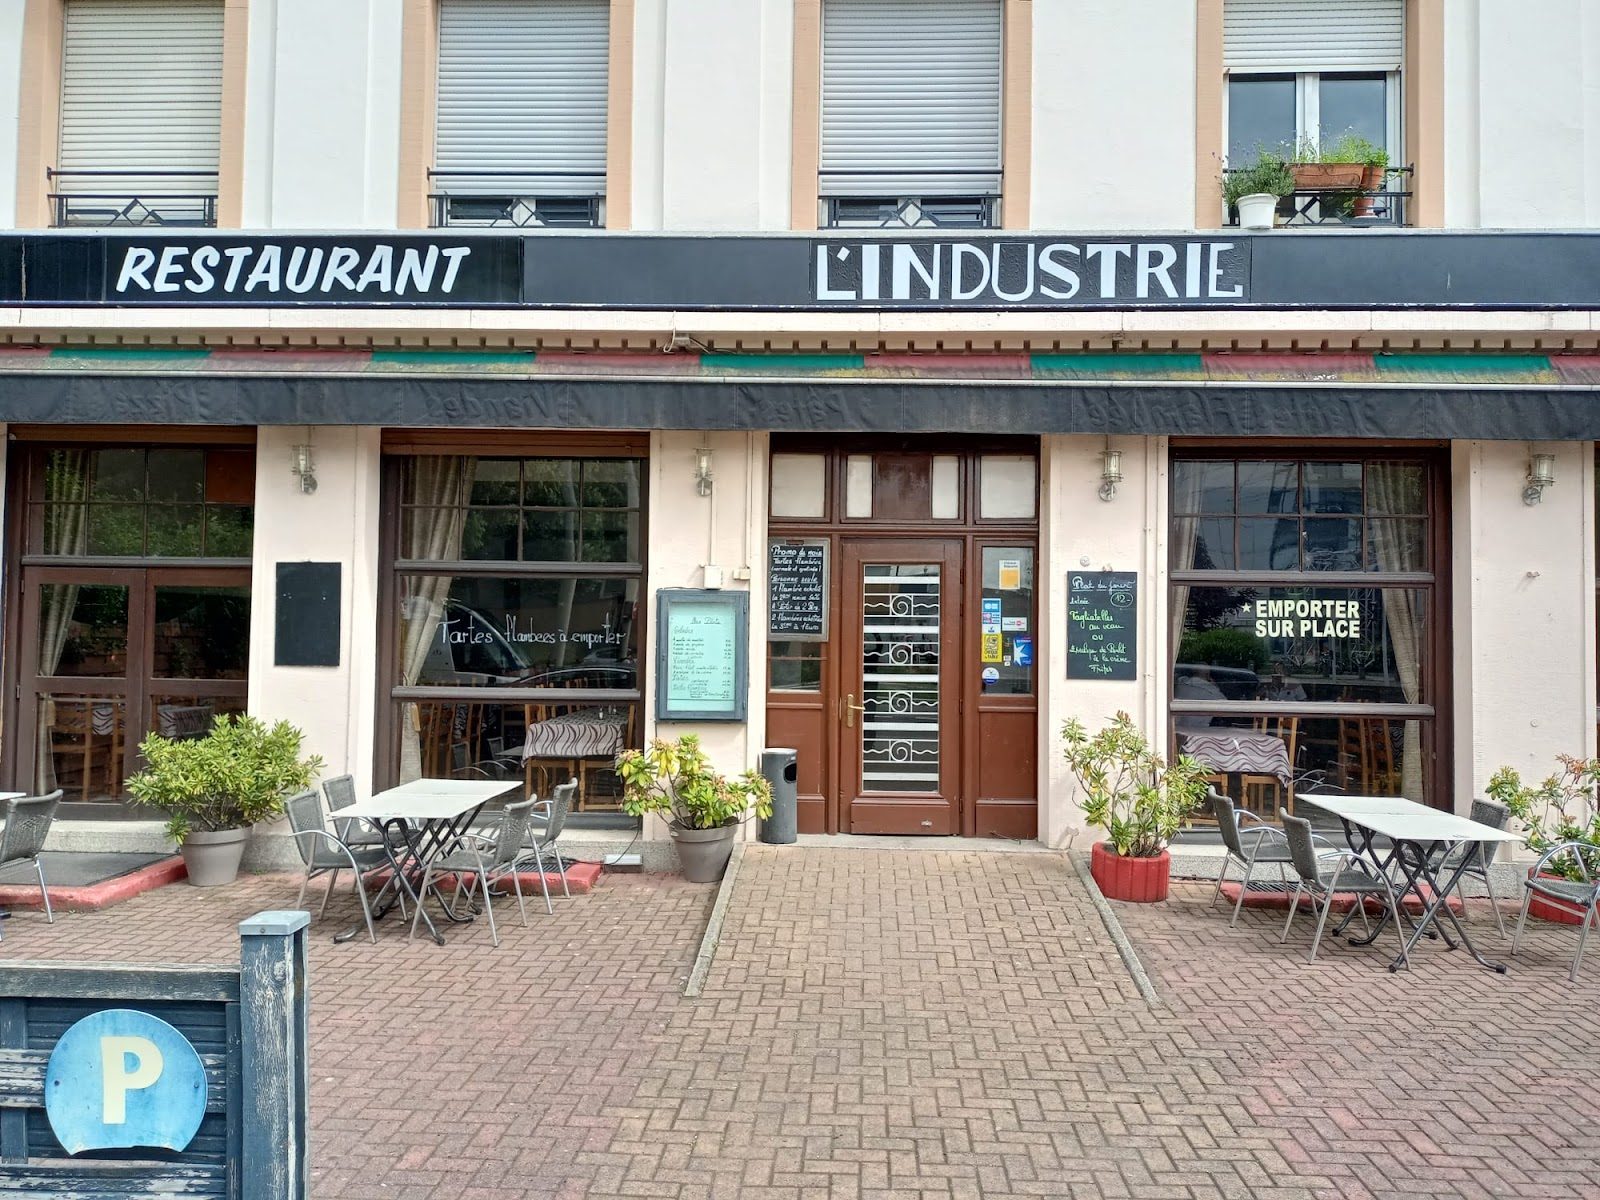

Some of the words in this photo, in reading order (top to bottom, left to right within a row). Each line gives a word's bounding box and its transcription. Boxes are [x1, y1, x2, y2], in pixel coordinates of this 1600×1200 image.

[116, 244, 471, 294] RESTAURANT
[816, 242, 1243, 302] L'INDUSTRIE
[771, 545, 797, 557] Promo
[1097, 580, 1107, 589] du
[1256, 600, 1360, 618] EMPORTER
[436, 615, 494, 644] Tartes
[559, 629, 569, 643] à
[570, 612, 627, 649] emporter
[1255, 619, 1294, 638] SUR
[1300, 619, 1361, 639] PLACE
[101, 1036, 164, 1125] P
